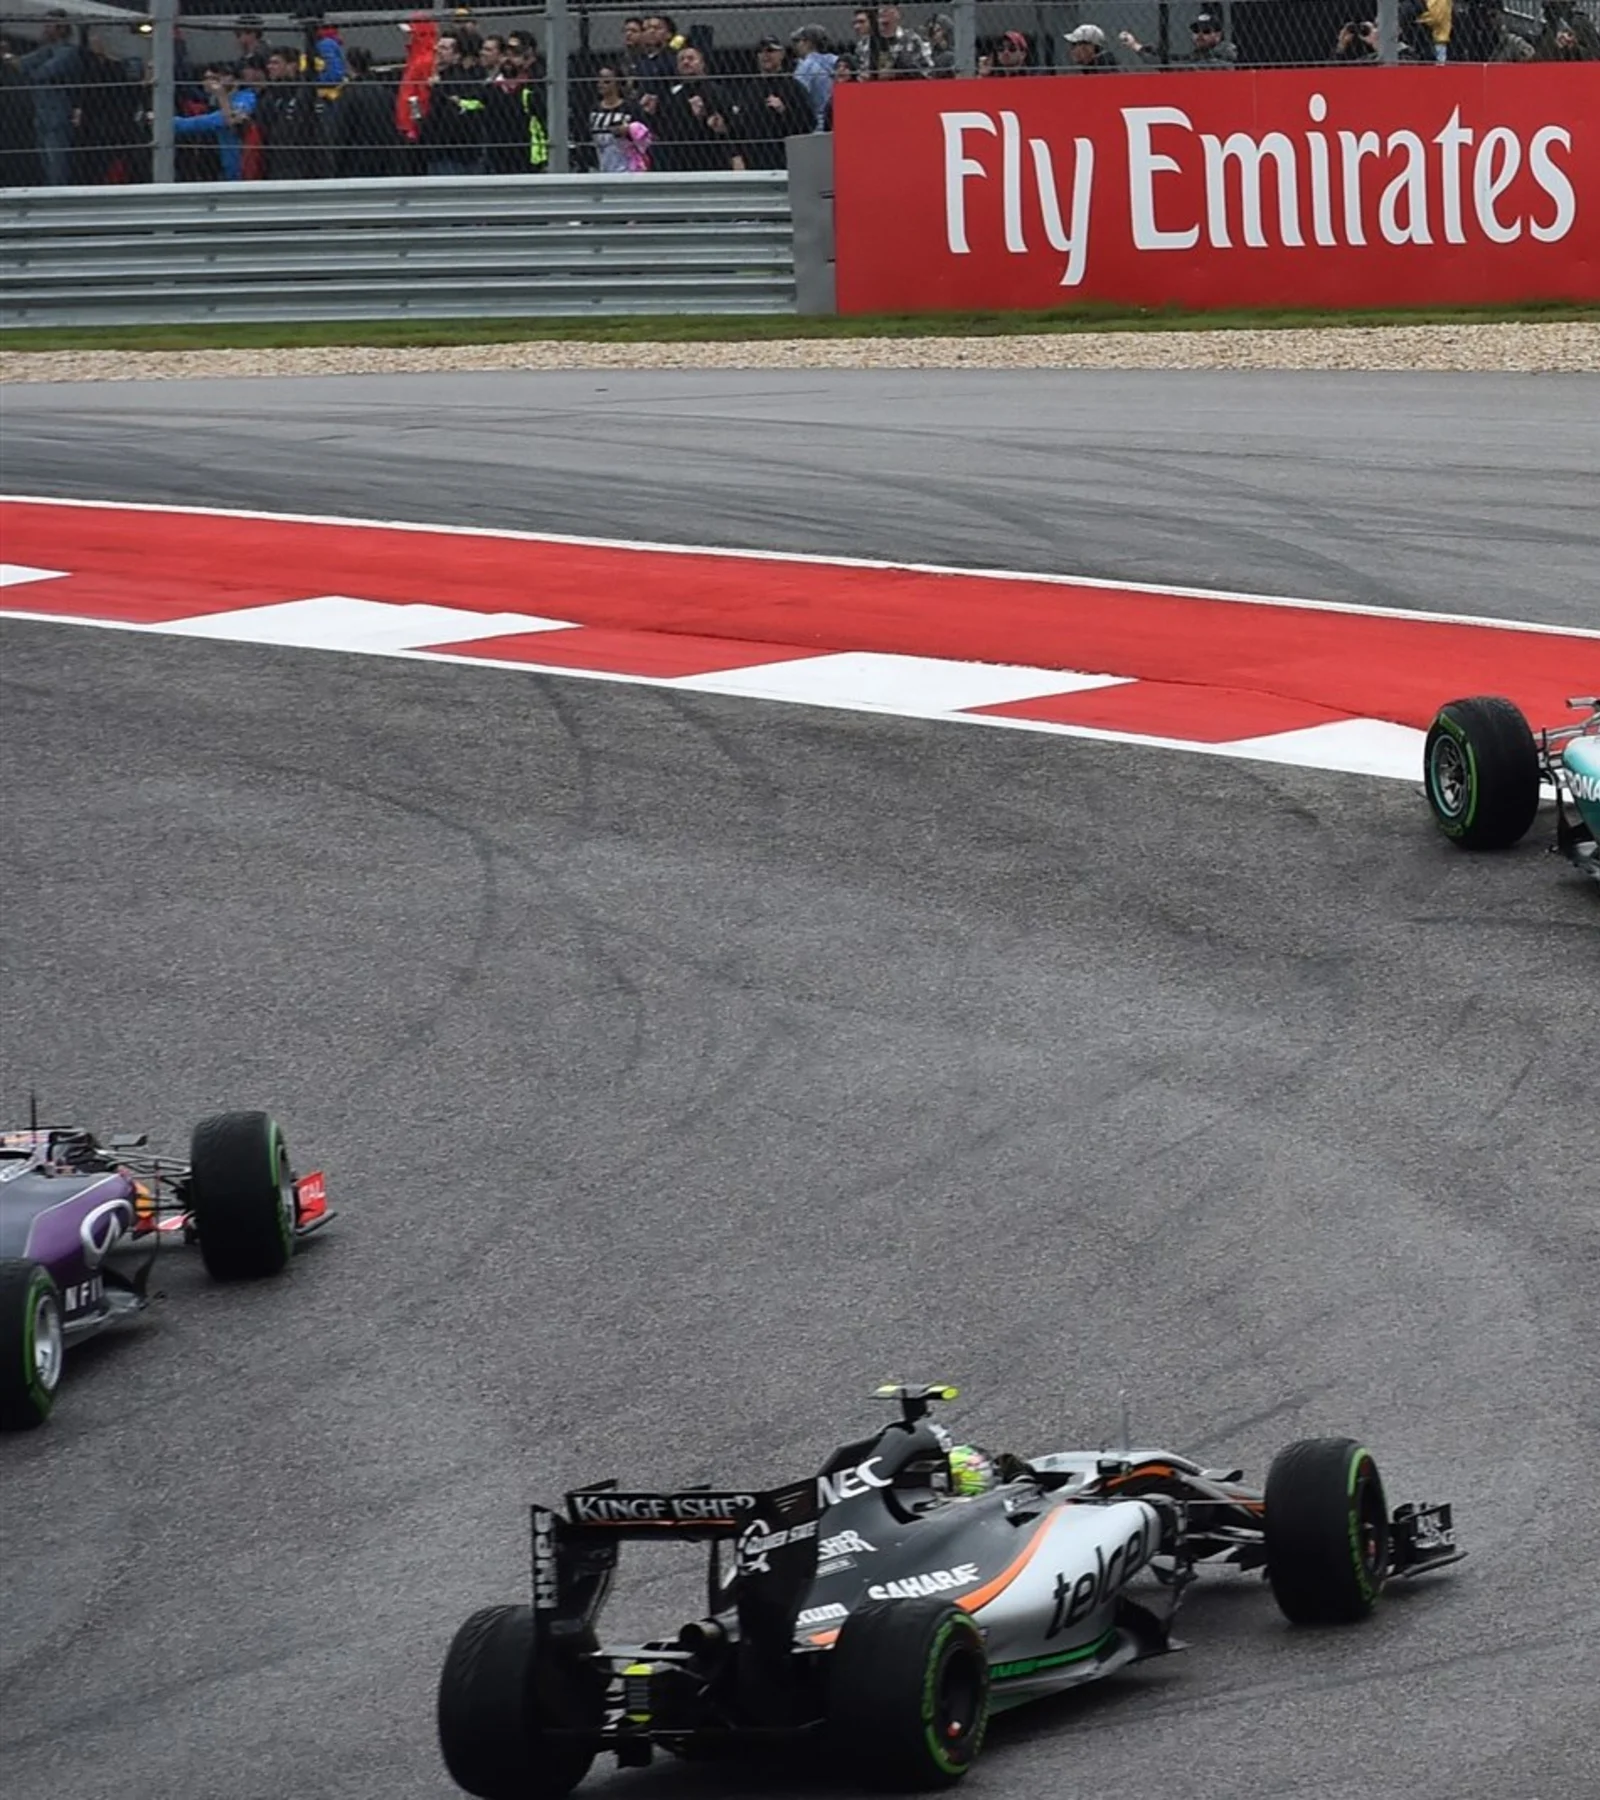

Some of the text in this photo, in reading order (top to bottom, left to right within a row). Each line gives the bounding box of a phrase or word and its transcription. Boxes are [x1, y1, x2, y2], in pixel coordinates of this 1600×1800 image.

[940, 93, 1576, 286] Fly Emirates
[816, 1456, 894, 1510] NEC
[867, 1562, 981, 1600] SAHARA
[1044, 1506, 1150, 1641] telcel
